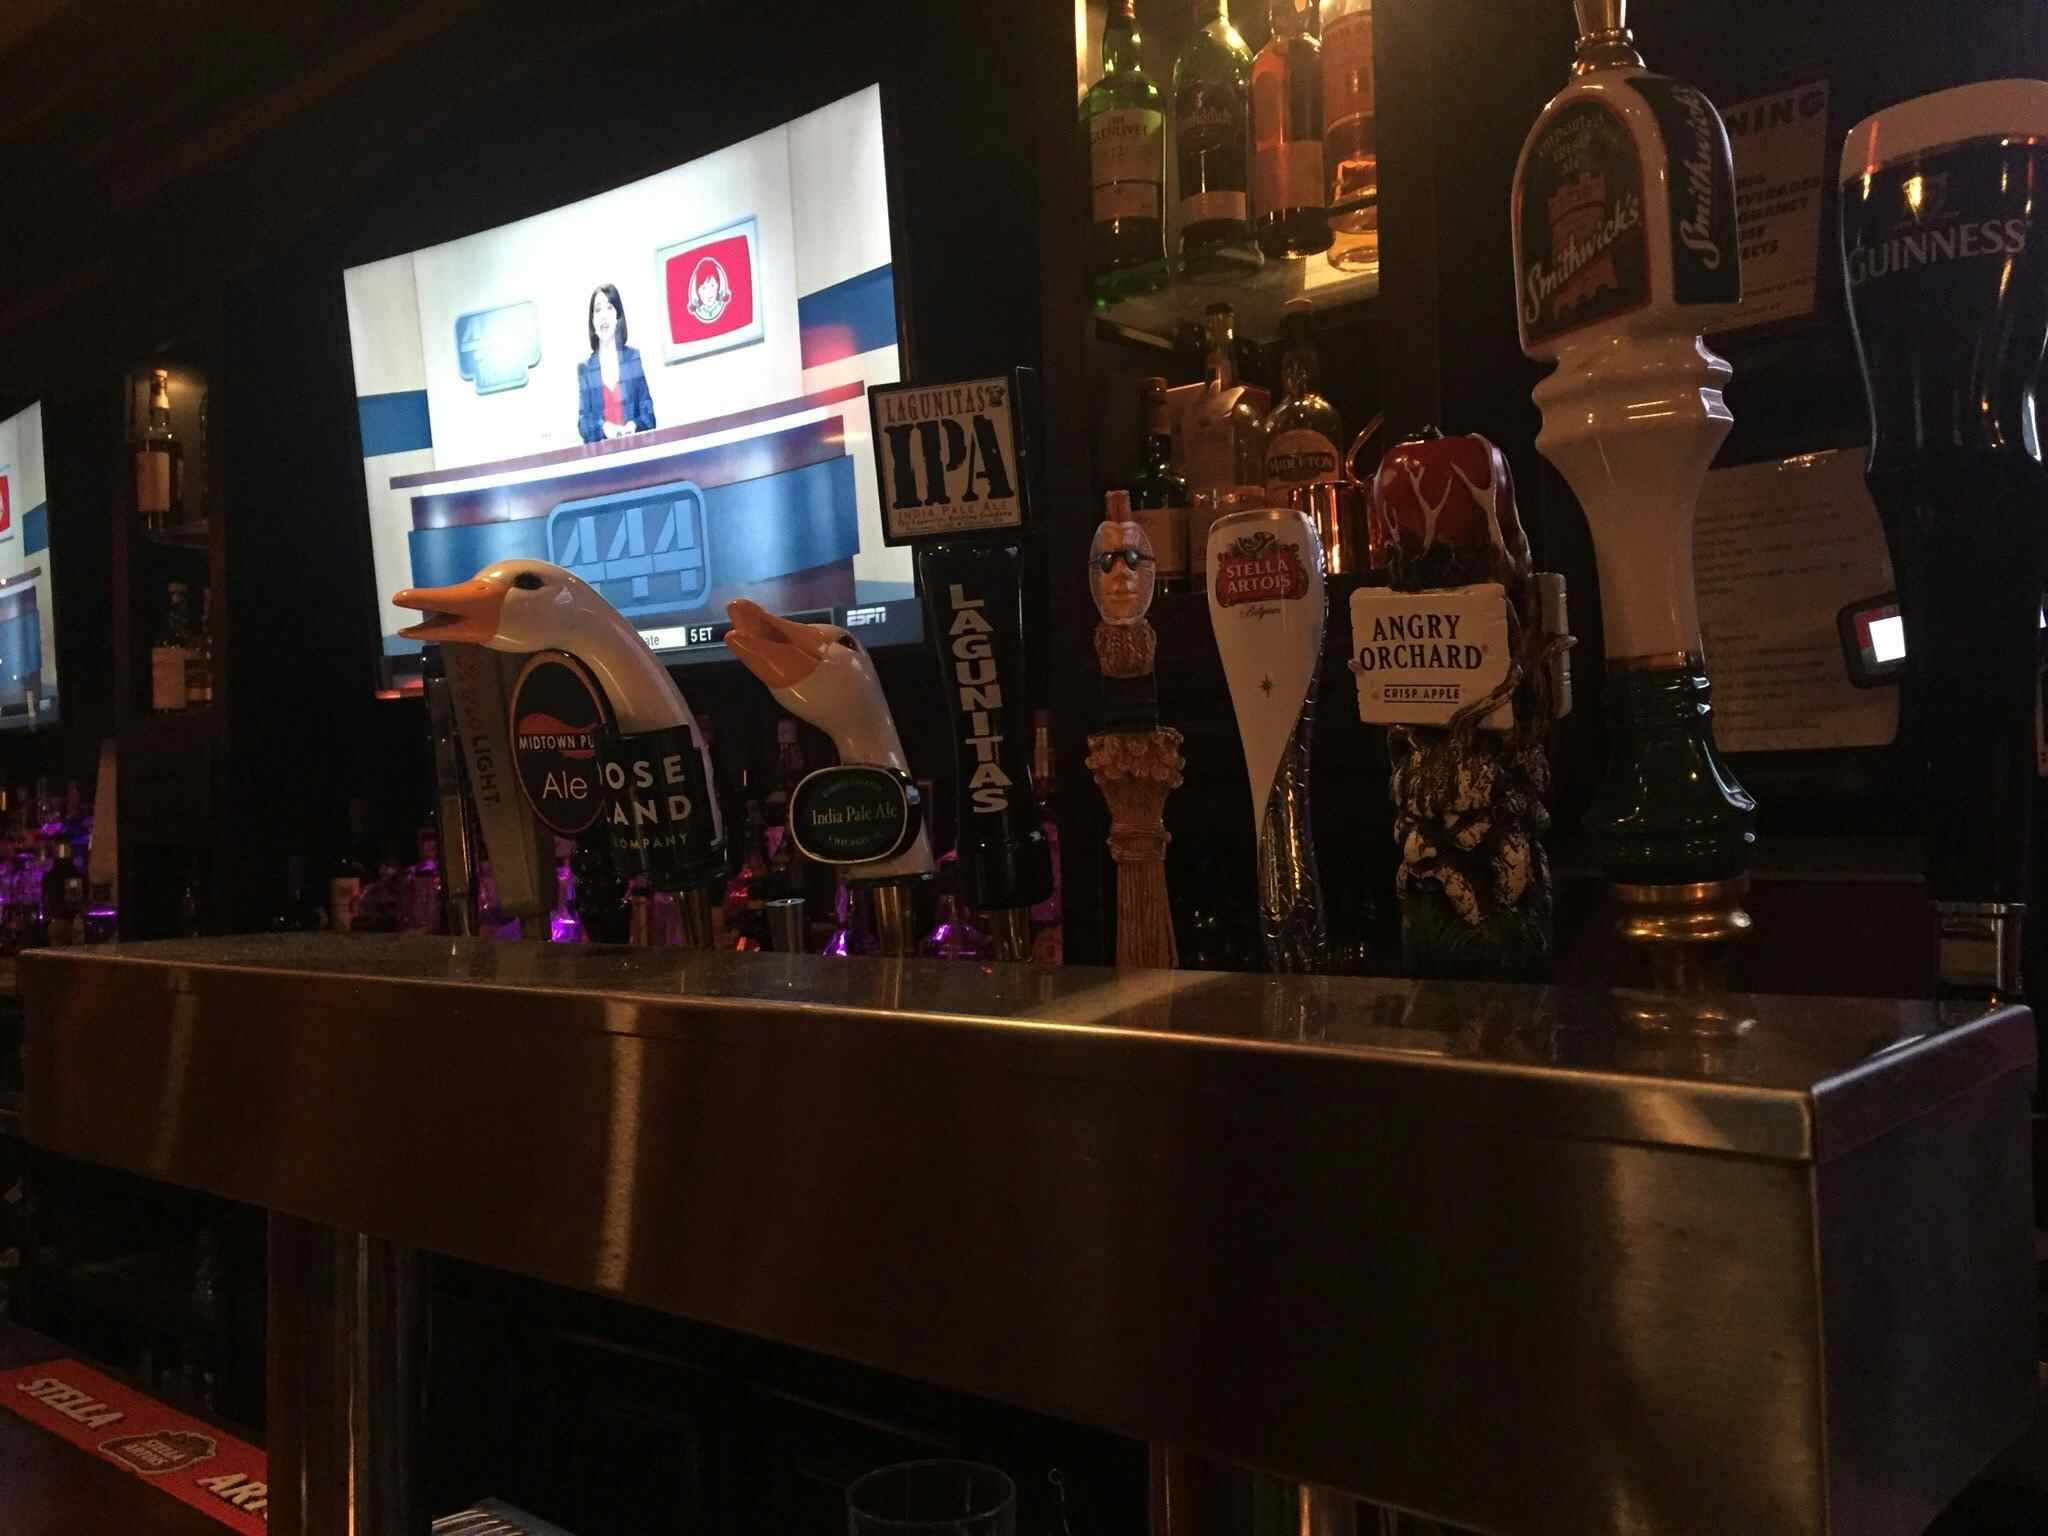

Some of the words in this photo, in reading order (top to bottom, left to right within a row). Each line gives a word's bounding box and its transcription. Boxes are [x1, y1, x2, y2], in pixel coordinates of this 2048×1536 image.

[1525, 191, 1641, 325] Smithwick's
[1849, 217, 2026, 286] GUINNESS
[885, 386, 986, 423] LAGUNITAS
[885, 415, 1015, 509] IPA
[1225, 558, 1289, 579] STELLA
[1226, 574, 1292, 595] ARTOIS
[846, 606, 888, 627] ESPN
[1372, 613, 1462, 643] ANGRY
[1359, 643, 1484, 672] ORCHARD
[948, 583, 1014, 814] LAGUNITAS
[1383, 686, 1419, 700] CRISP
[1423, 685, 1461, 700] APPLE
[518, 734, 576, 751] MIDTOWN
[472, 736, 501, 807] LIGHT
[541, 768, 589, 801] Ale
[596, 752, 687, 792] OSE
[604, 793, 693, 826] AND
[809, 807, 845, 826] India
[846, 804, 872, 823] Pale
[874, 800, 898, 818] Ale
[16, 1376, 127, 1430] STELLA
[195, 1471, 269, 1517] AR
